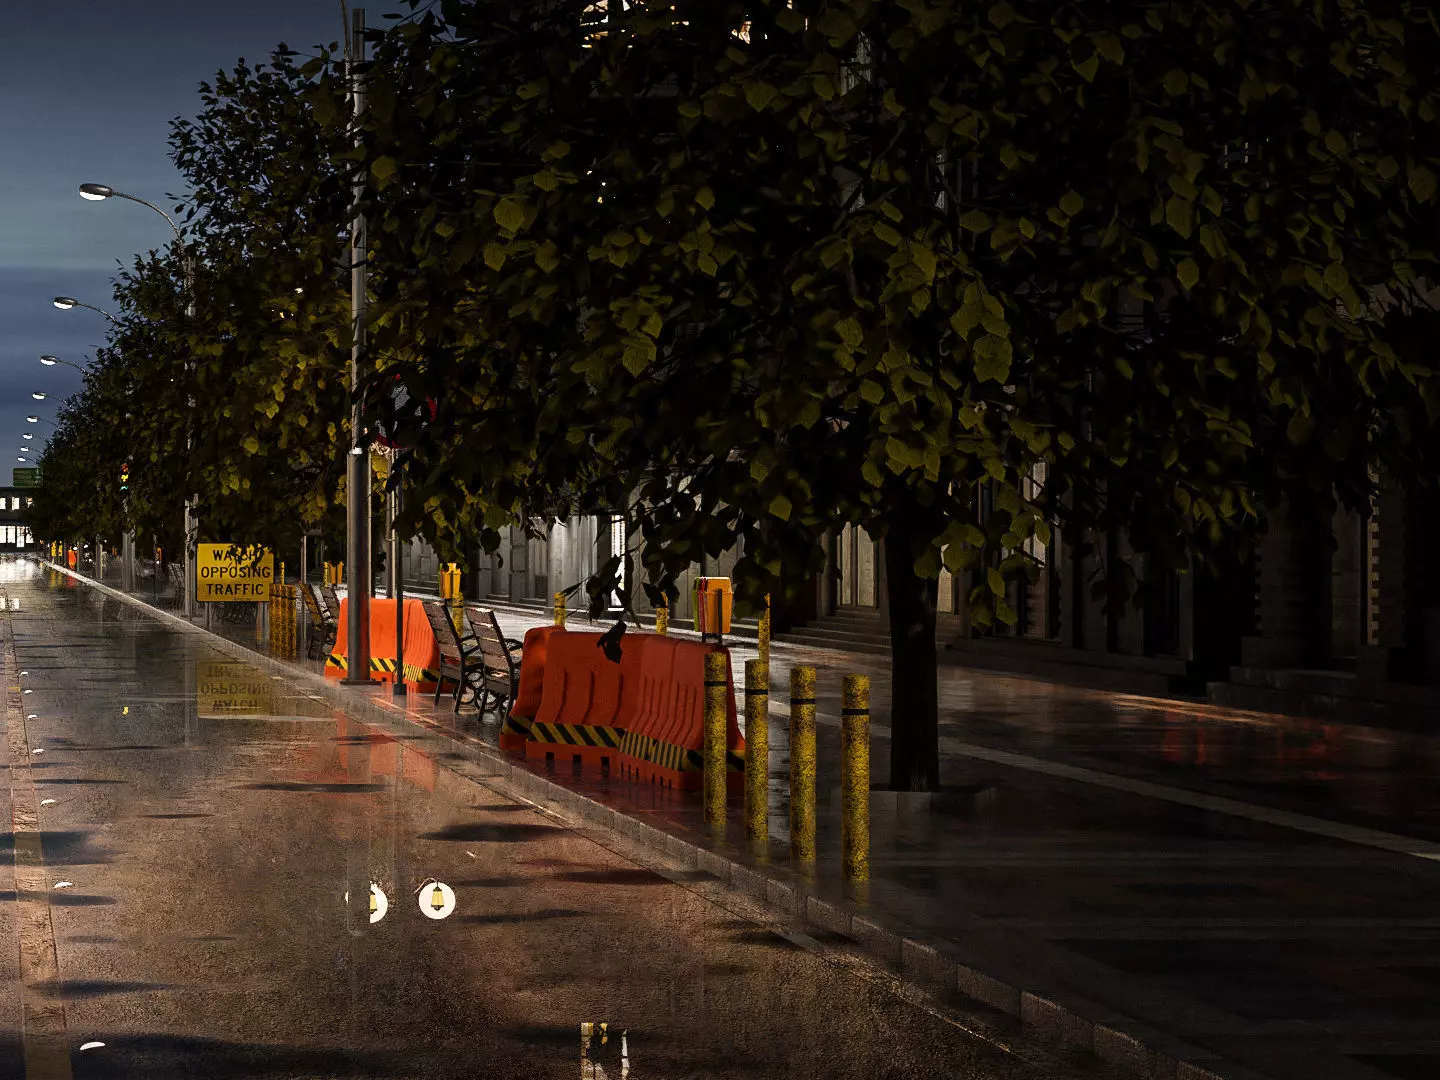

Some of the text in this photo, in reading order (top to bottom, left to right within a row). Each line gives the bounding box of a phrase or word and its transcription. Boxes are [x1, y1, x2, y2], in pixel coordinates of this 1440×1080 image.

[213, 550, 259, 561] WACH
[201, 566, 271, 578] OPPOSING
[206, 583, 264, 595] TRAFFIC
